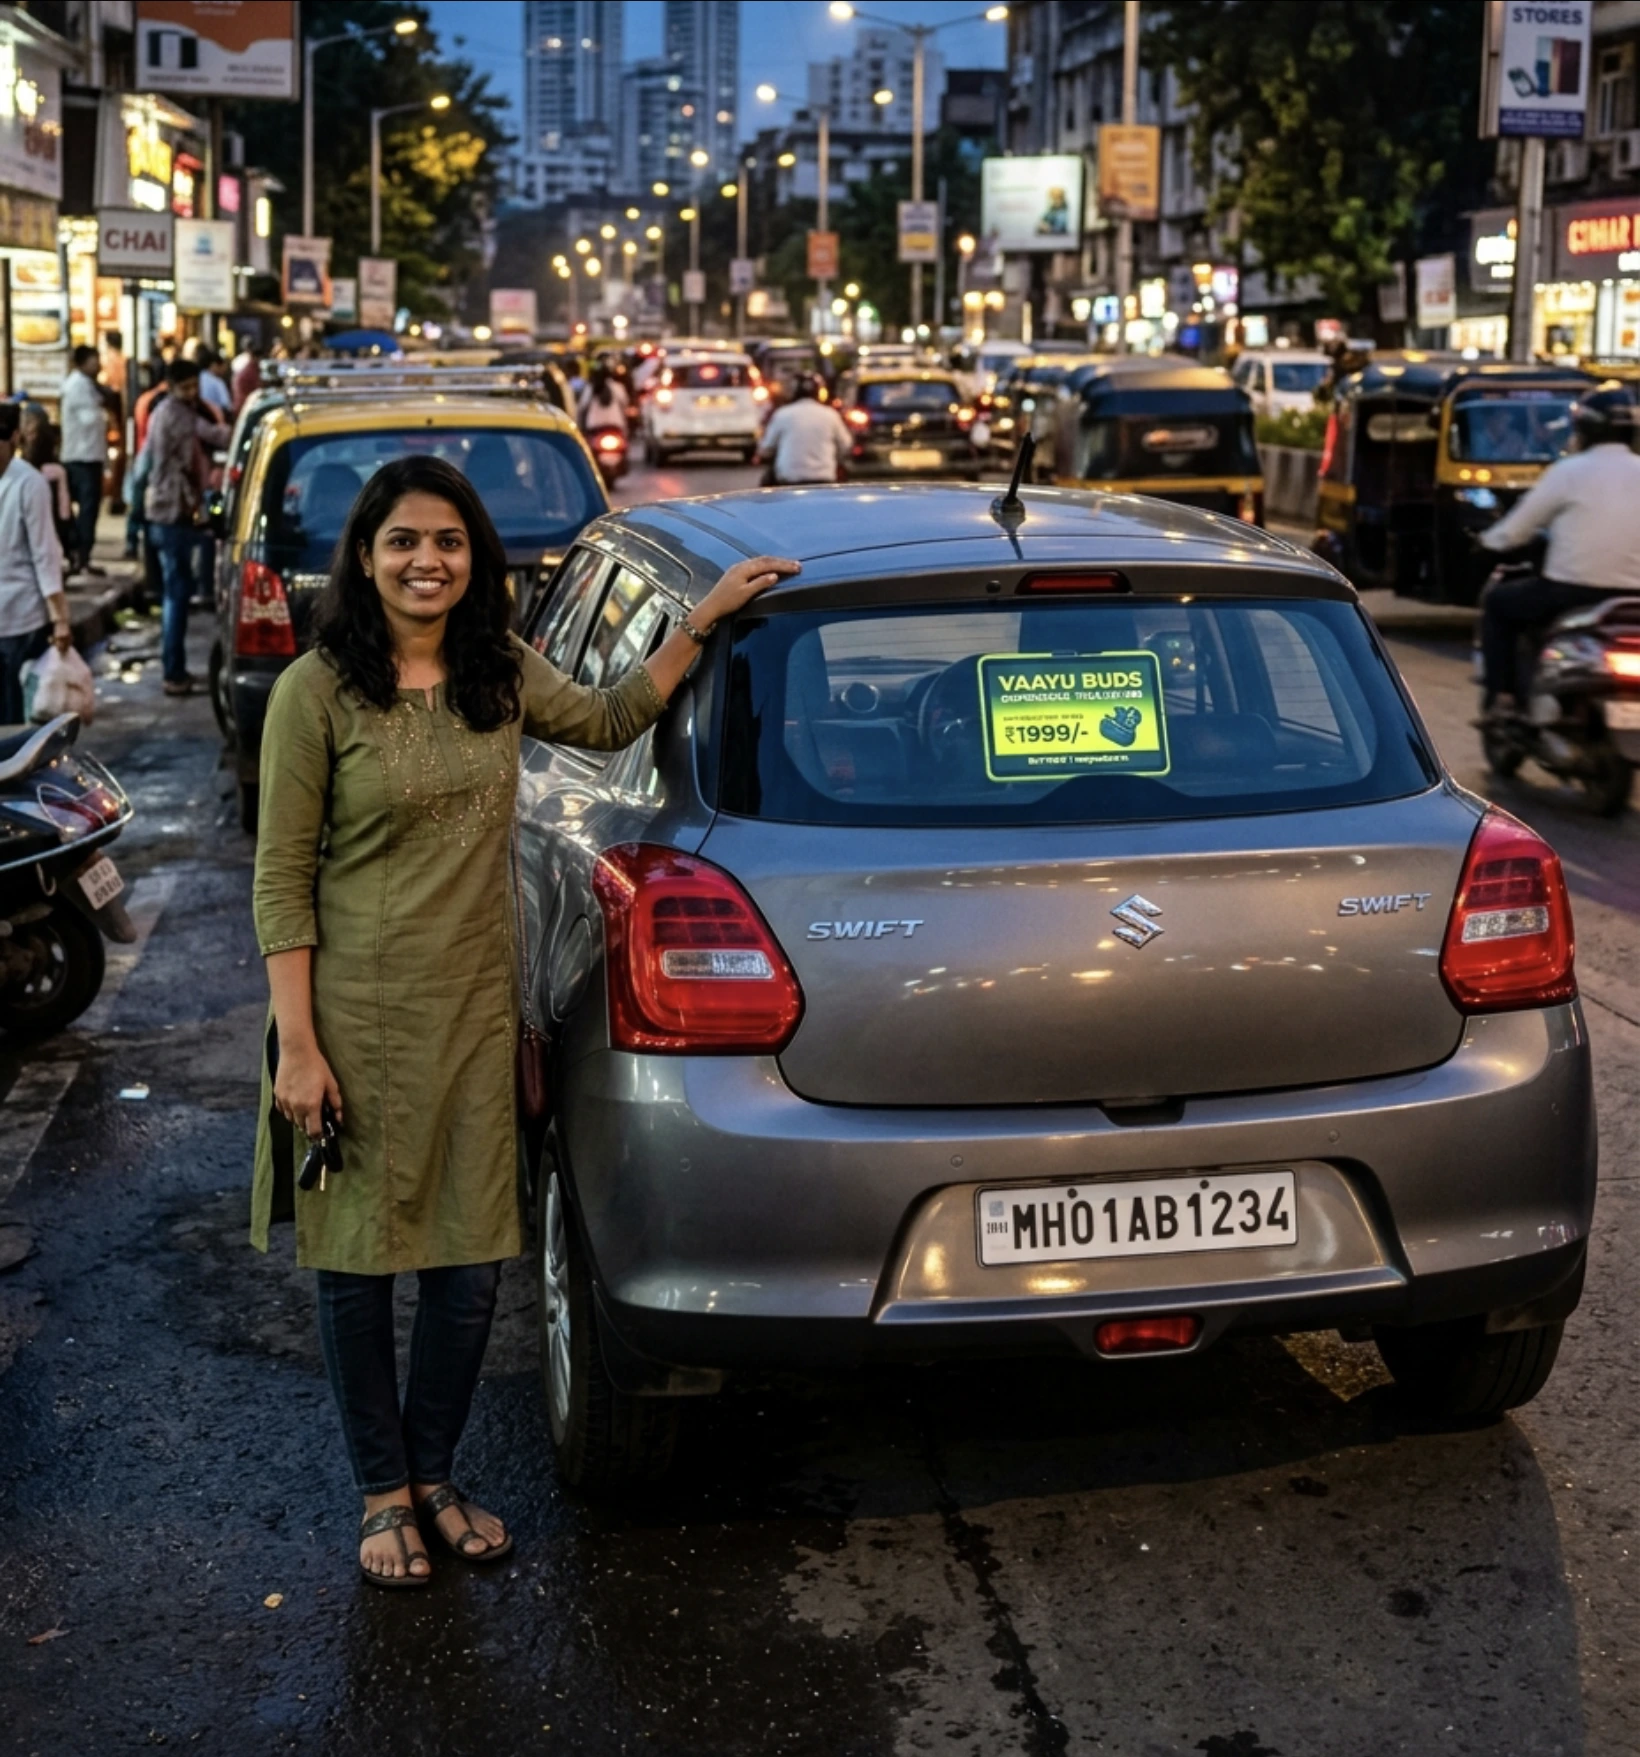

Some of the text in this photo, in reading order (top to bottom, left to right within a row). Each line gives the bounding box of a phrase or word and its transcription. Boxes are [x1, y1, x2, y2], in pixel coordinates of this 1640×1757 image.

[1512, 8, 1583, 25] STORES
[105, 228, 166, 253] CHAI
[998, 671, 1143, 692] VAAYU BUDS
[1337, 892, 1432, 917] SWIFT
[806, 918, 925, 941] SWIFT
[1012, 1186, 1290, 1250] MH01AB1234
